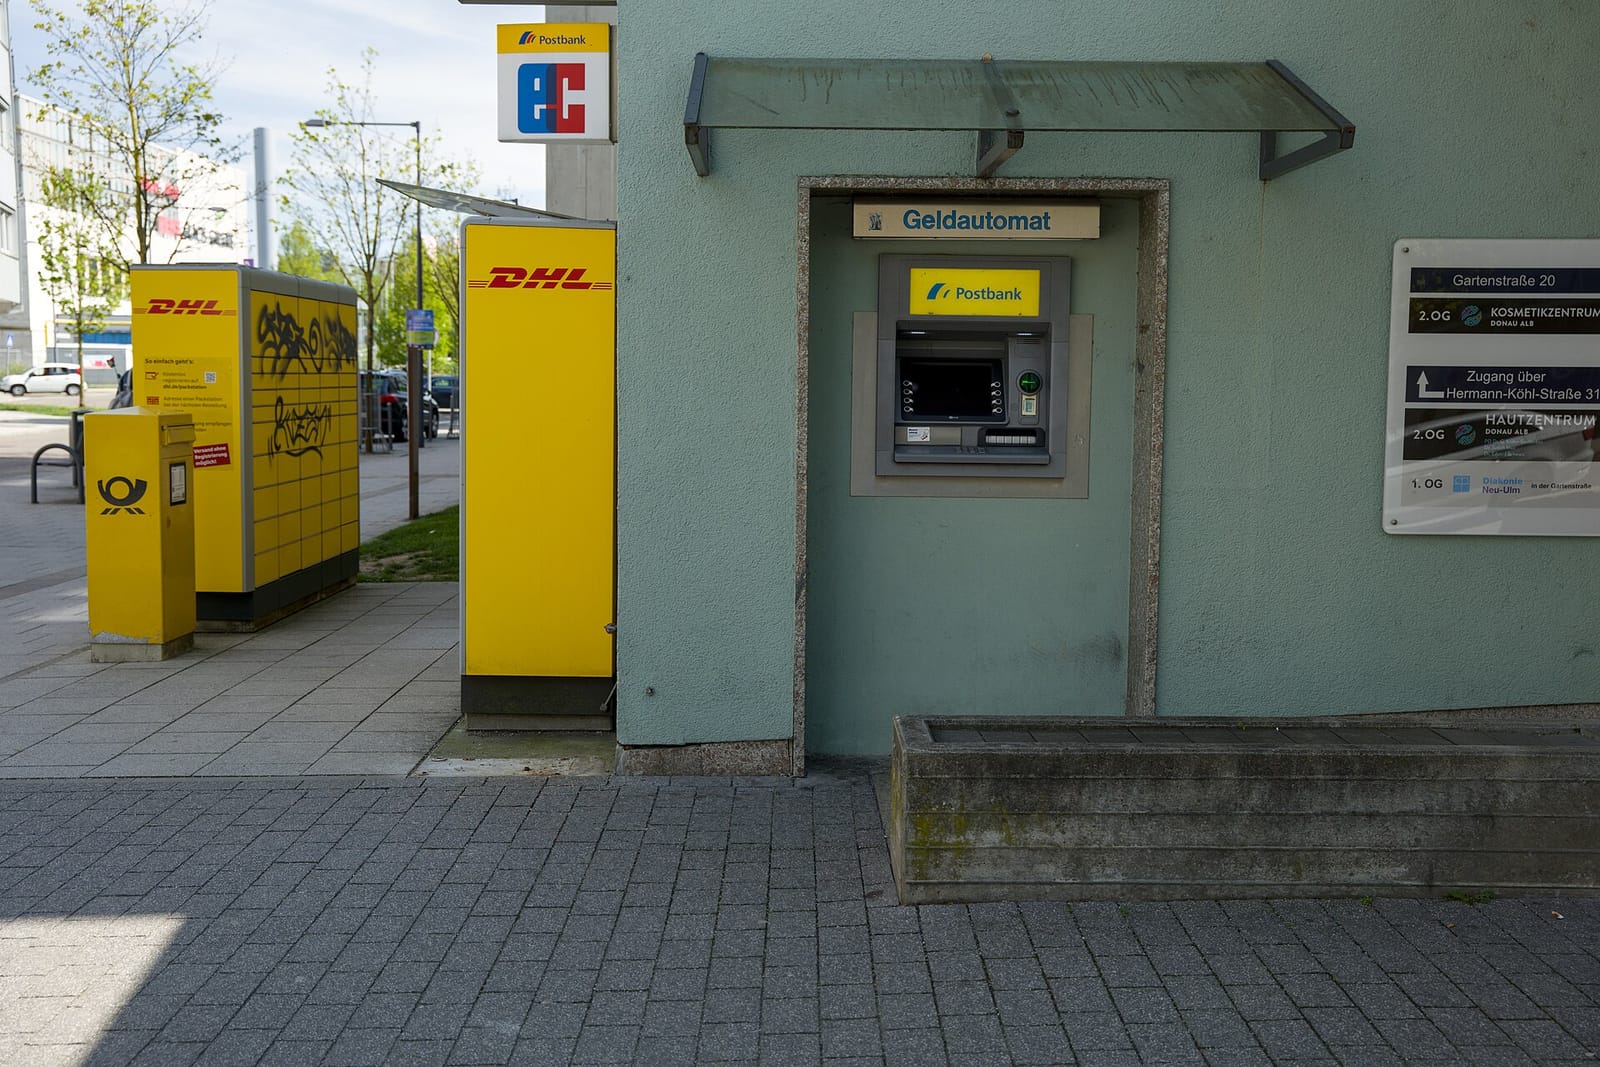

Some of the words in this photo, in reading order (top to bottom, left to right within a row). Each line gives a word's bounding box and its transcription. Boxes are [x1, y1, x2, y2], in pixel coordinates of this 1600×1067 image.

[539, 35, 586, 45] Postbank
[902, 209, 1051, 231] Geldautomat
[488, 267, 592, 289] DHL
[1453, 274, 1536, 287] Gartenstraße
[1539, 275, 1556, 287] 20
[956, 287, 1022, 300] Postbank
[147, 299, 223, 315] DHL
[1490, 307, 1600, 318] KOSMETIKZENTRUM
[1466, 371, 1514, 384] Zugang
[1518, 371, 1546, 382] über
[1446, 387, 1582, 400] Hermann-Köhl-Straße
[1585, 388, 1600, 400] 31
[1485, 414, 1596, 426] HAUTZENTRUM
[194, 452, 228, 460] Registrierung
[1411, 479, 1421, 488] 1.
[1424, 479, 1443, 489] OG
[1483, 477, 1523, 485] Diakonie
[1482, 486, 1520, 494] Neu-Ulm
